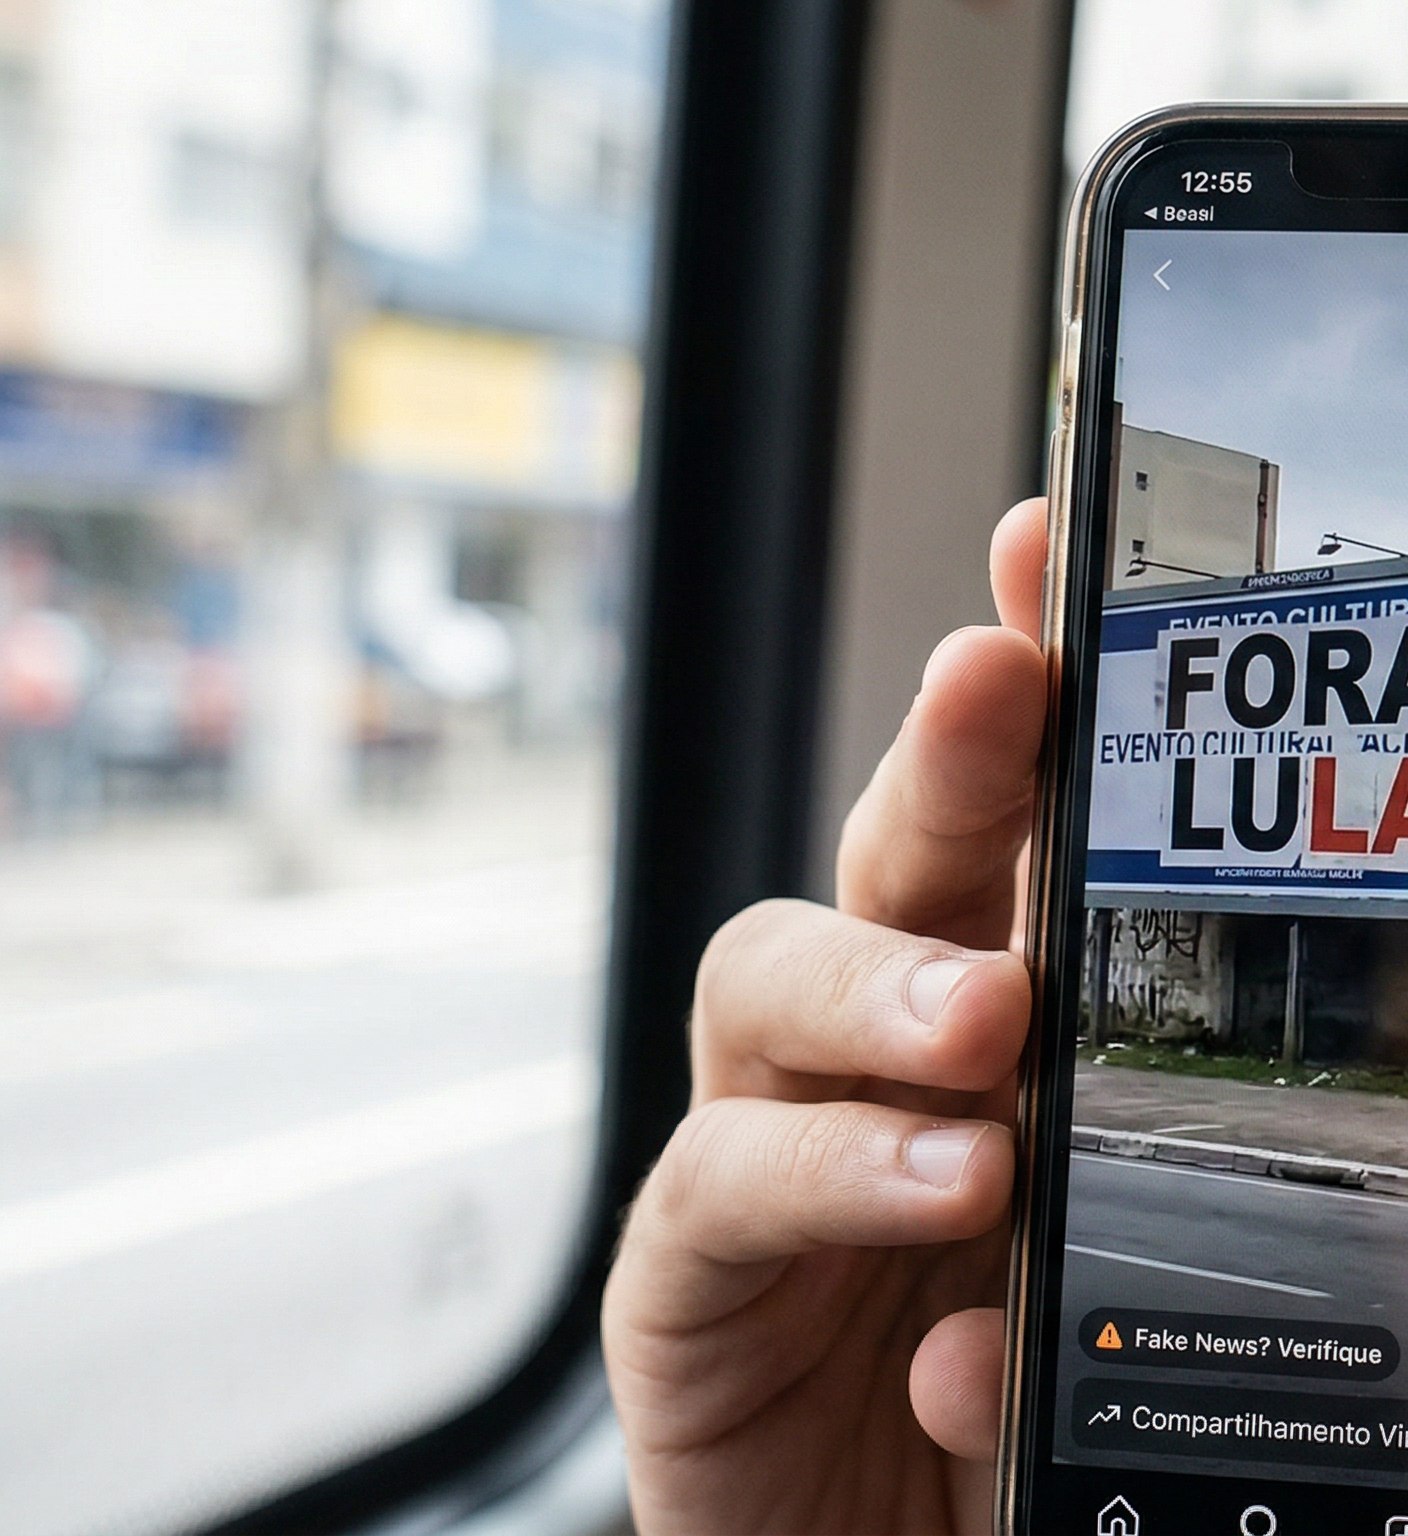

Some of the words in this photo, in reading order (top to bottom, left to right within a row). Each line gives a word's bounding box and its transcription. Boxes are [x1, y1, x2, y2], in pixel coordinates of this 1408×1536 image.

[1181, 171, 1253, 193] 12:55
[1100, 732, 1195, 763] EVENTO
[1135, 1328, 1188, 1351] Fake
[1195, 1332, 1271, 1357] News?
[1278, 1337, 1383, 1367] Verifique
[1132, 1406, 1371, 1446] Compartilhamento
